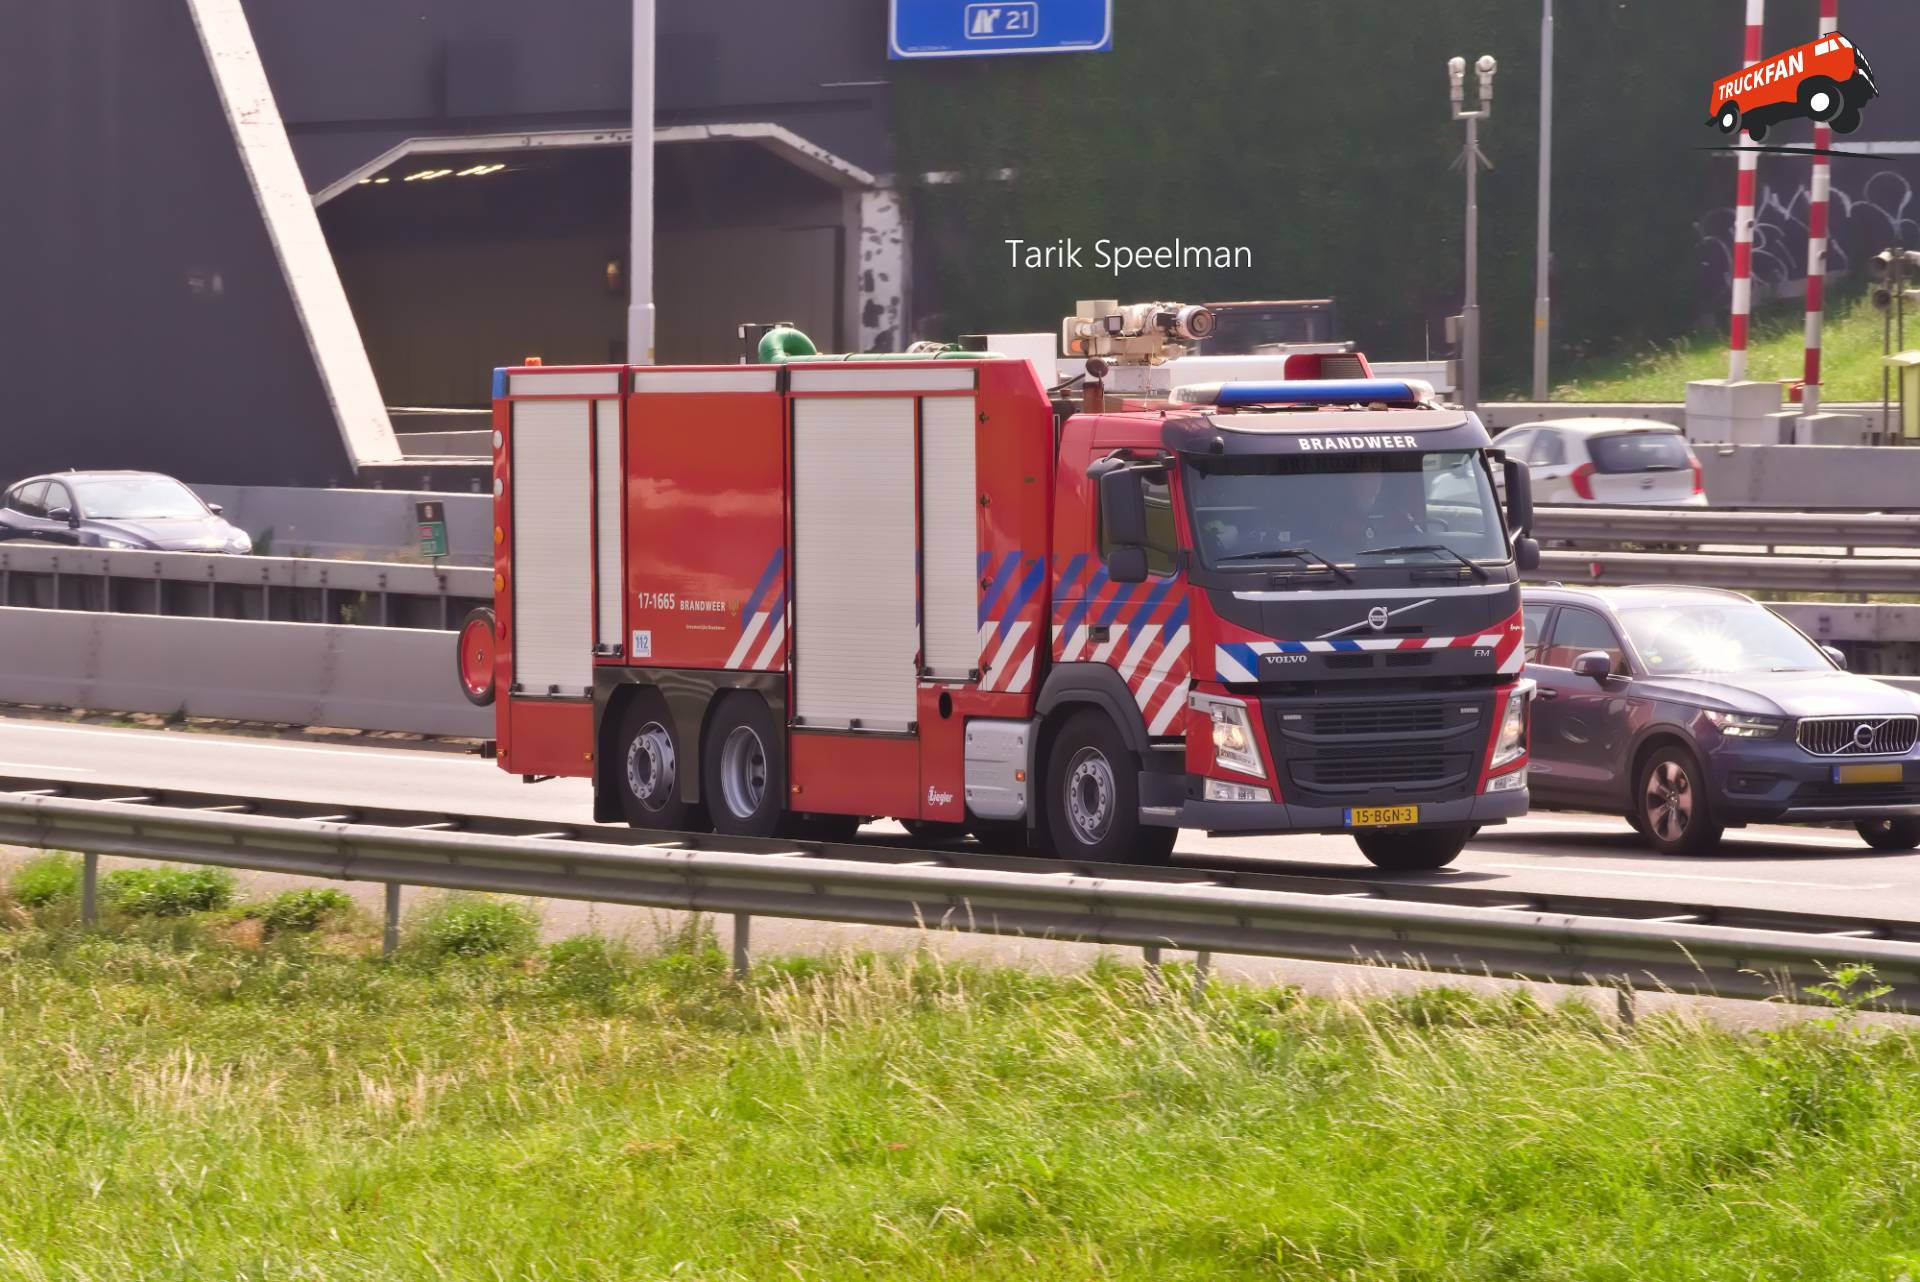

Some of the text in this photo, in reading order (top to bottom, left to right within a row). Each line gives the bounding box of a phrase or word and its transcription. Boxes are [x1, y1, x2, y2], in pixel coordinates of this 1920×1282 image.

[1005, 10, 1029, 30] 21
[1298, 435, 1418, 450] BRANDWEER
[638, 592, 726, 611] 17-1665 BRANDWEER
[1265, 655, 1308, 664] VOLVO
[1474, 649, 1490, 657] FM
[1356, 808, 1412, 824] 15-BGN-3
